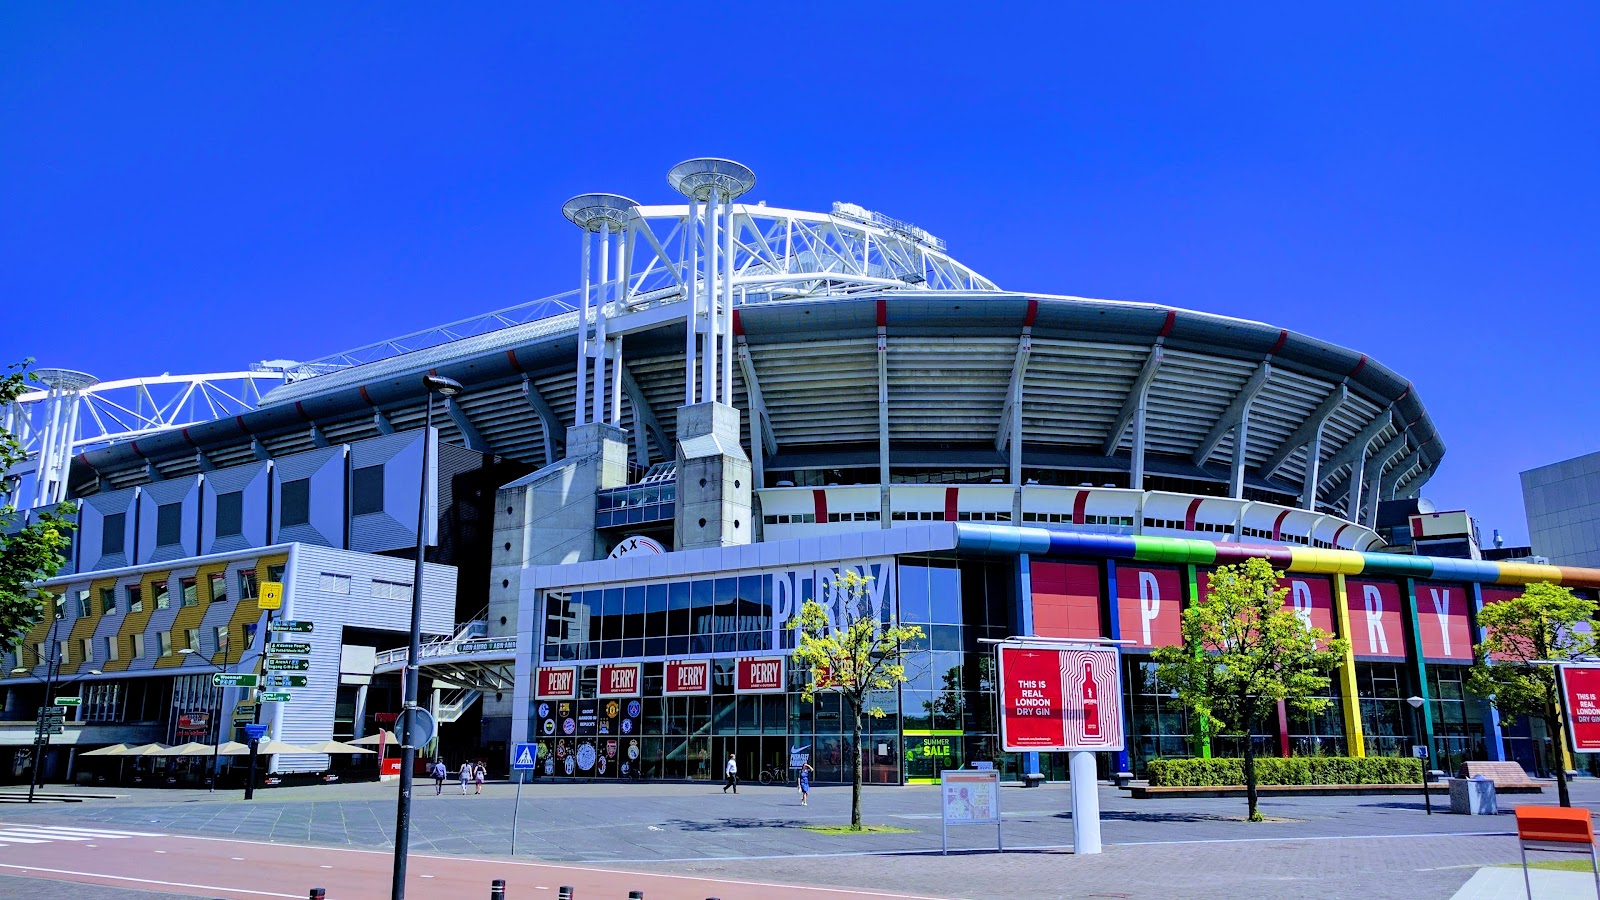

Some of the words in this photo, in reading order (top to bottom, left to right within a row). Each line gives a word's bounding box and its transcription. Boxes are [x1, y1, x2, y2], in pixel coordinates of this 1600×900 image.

[610, 669, 636, 689] PERRY
[678, 666, 704, 686] PERRY
[751, 662, 779, 684] PERRY
[548, 672, 572, 691] PERRY
[1018, 680, 1037, 688] THIS
[1015, 698, 1050, 706] LONDON
[1016, 708, 1033, 716] DRY
[1036, 708, 1050, 716] GIN
[923, 746, 950, 756] SALE
